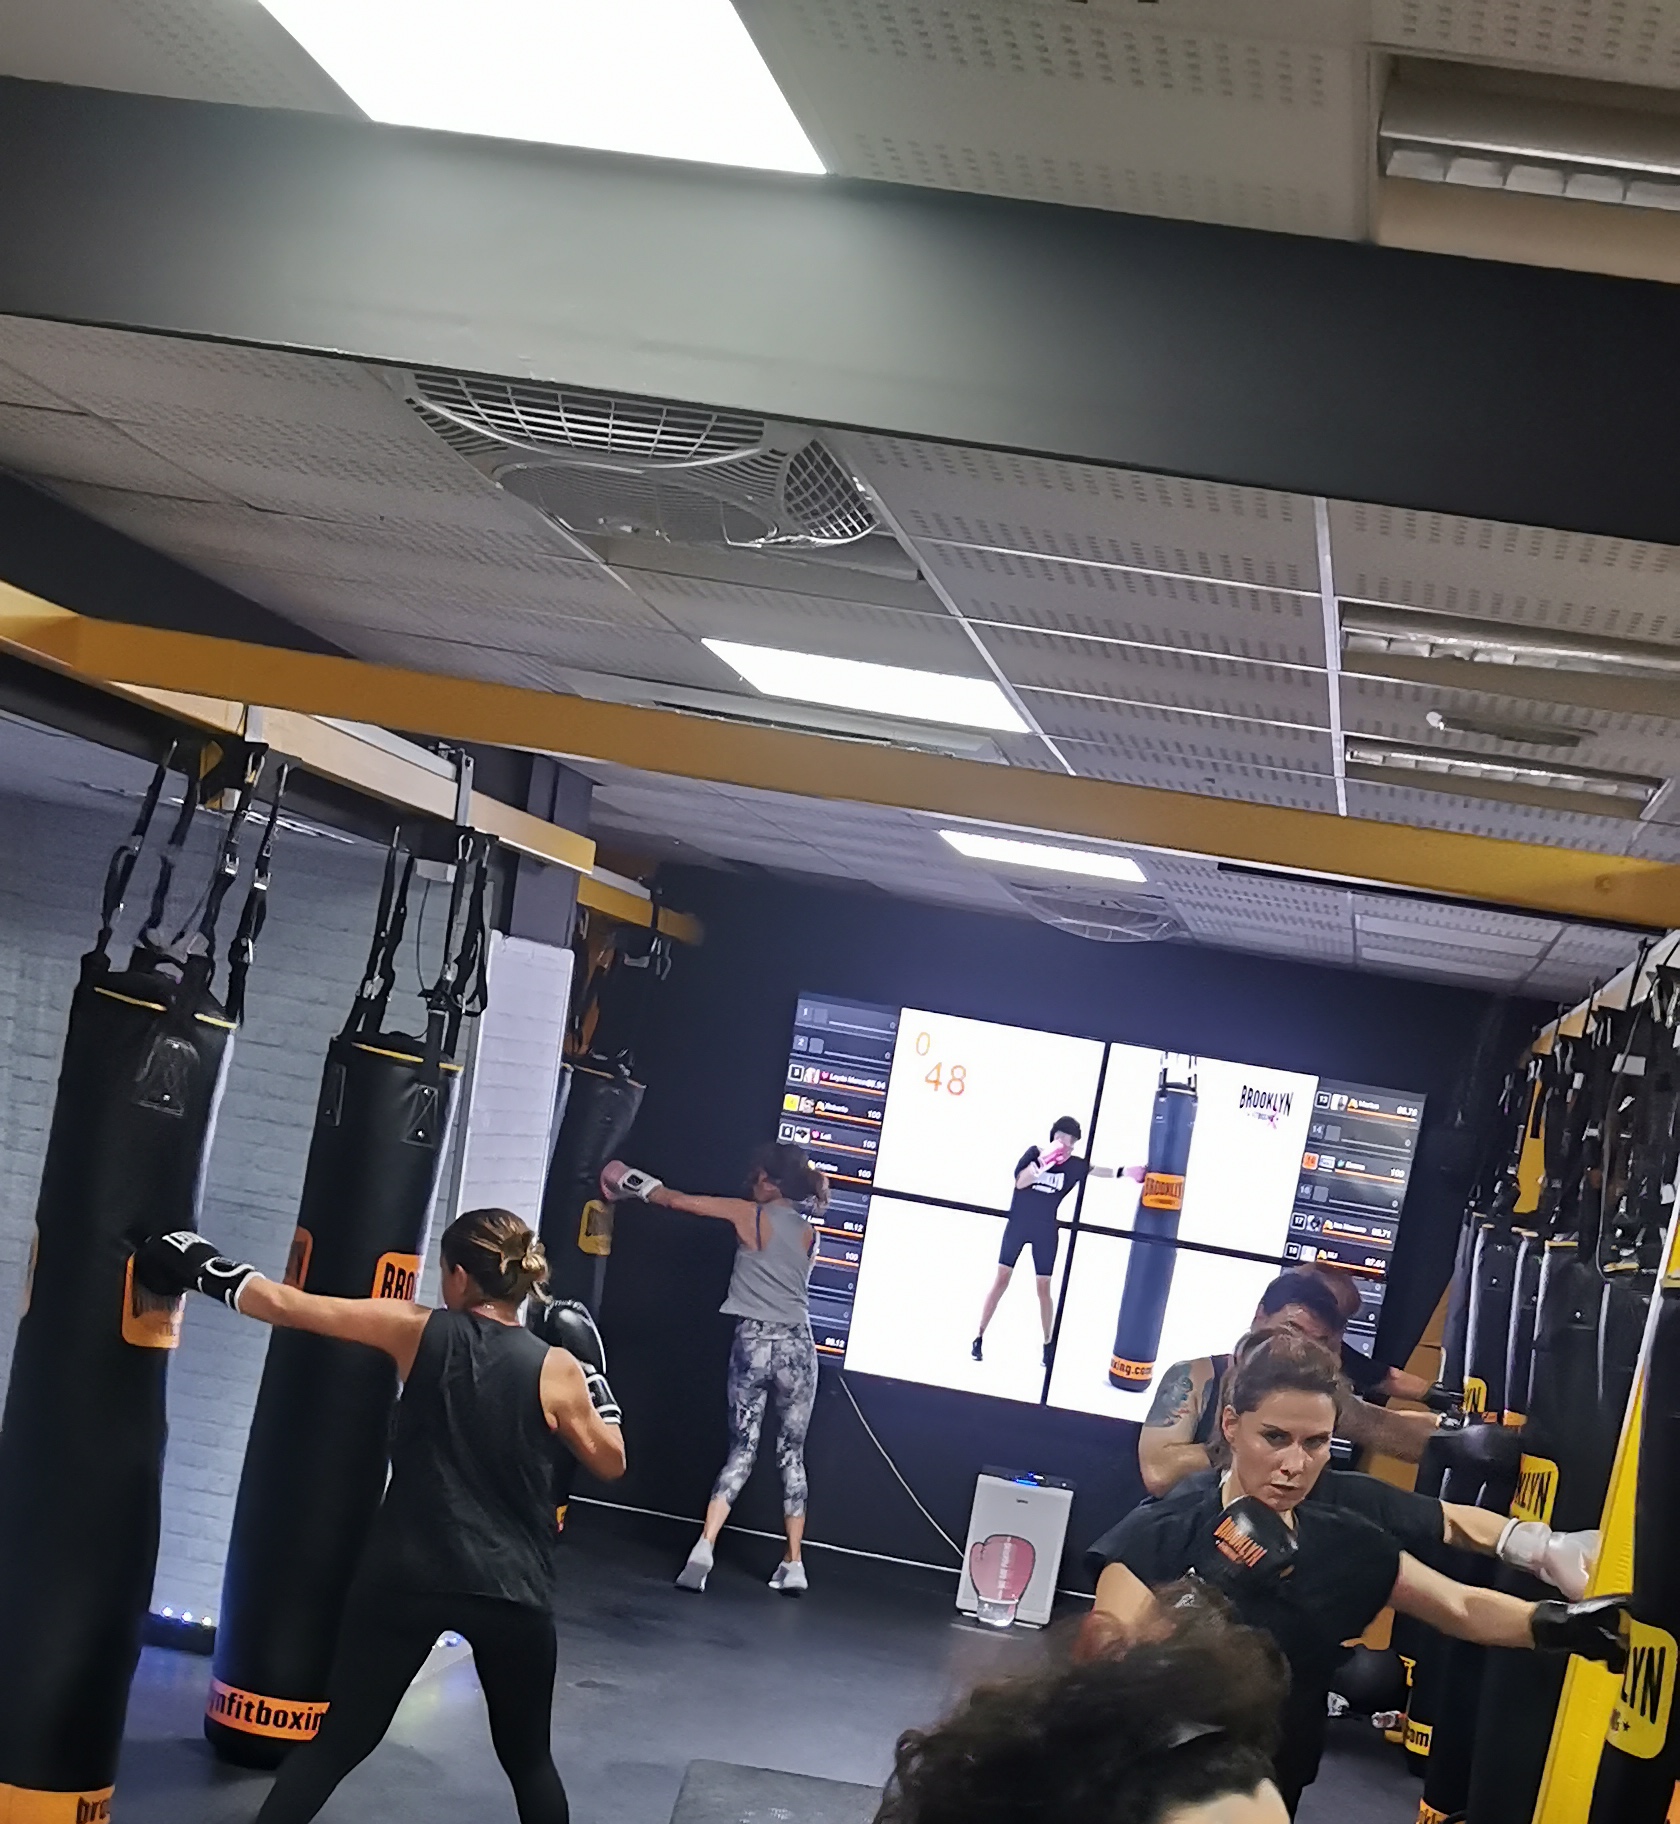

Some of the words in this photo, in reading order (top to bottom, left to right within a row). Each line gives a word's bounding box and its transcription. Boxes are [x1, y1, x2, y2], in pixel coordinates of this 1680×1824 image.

[915, 1031, 931, 1056] 0
[924, 1061, 967, 1096] 48
[1239, 1084, 1294, 1117] BROOKLYN
[867, 1109, 882, 1120] 100
[862, 1139, 877, 1149] 100
[857, 1169, 872, 1179] 100
[1390, 1168, 1406, 1178] 100
[845, 1250, 859, 1262] 100
